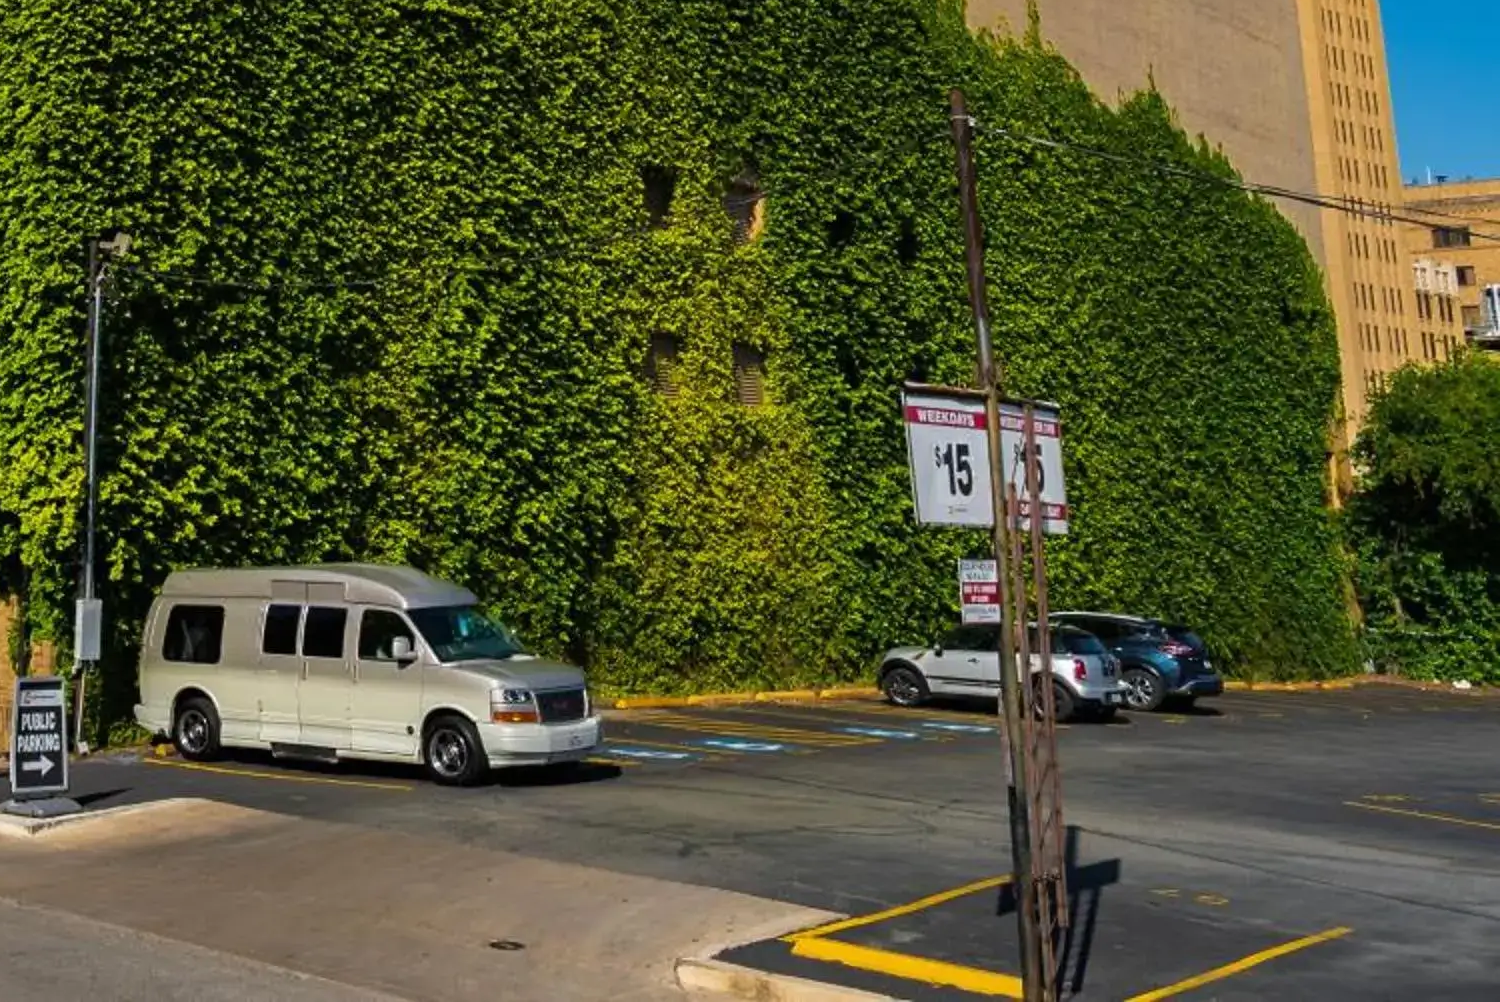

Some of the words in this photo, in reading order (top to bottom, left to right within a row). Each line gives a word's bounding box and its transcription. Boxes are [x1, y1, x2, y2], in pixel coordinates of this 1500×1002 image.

[916, 408, 975, 427] WEEKDAYS
[935, 443, 973, 496] $15
[21, 711, 57, 731] PUBLIC
[17, 733, 61, 753] PARKING
